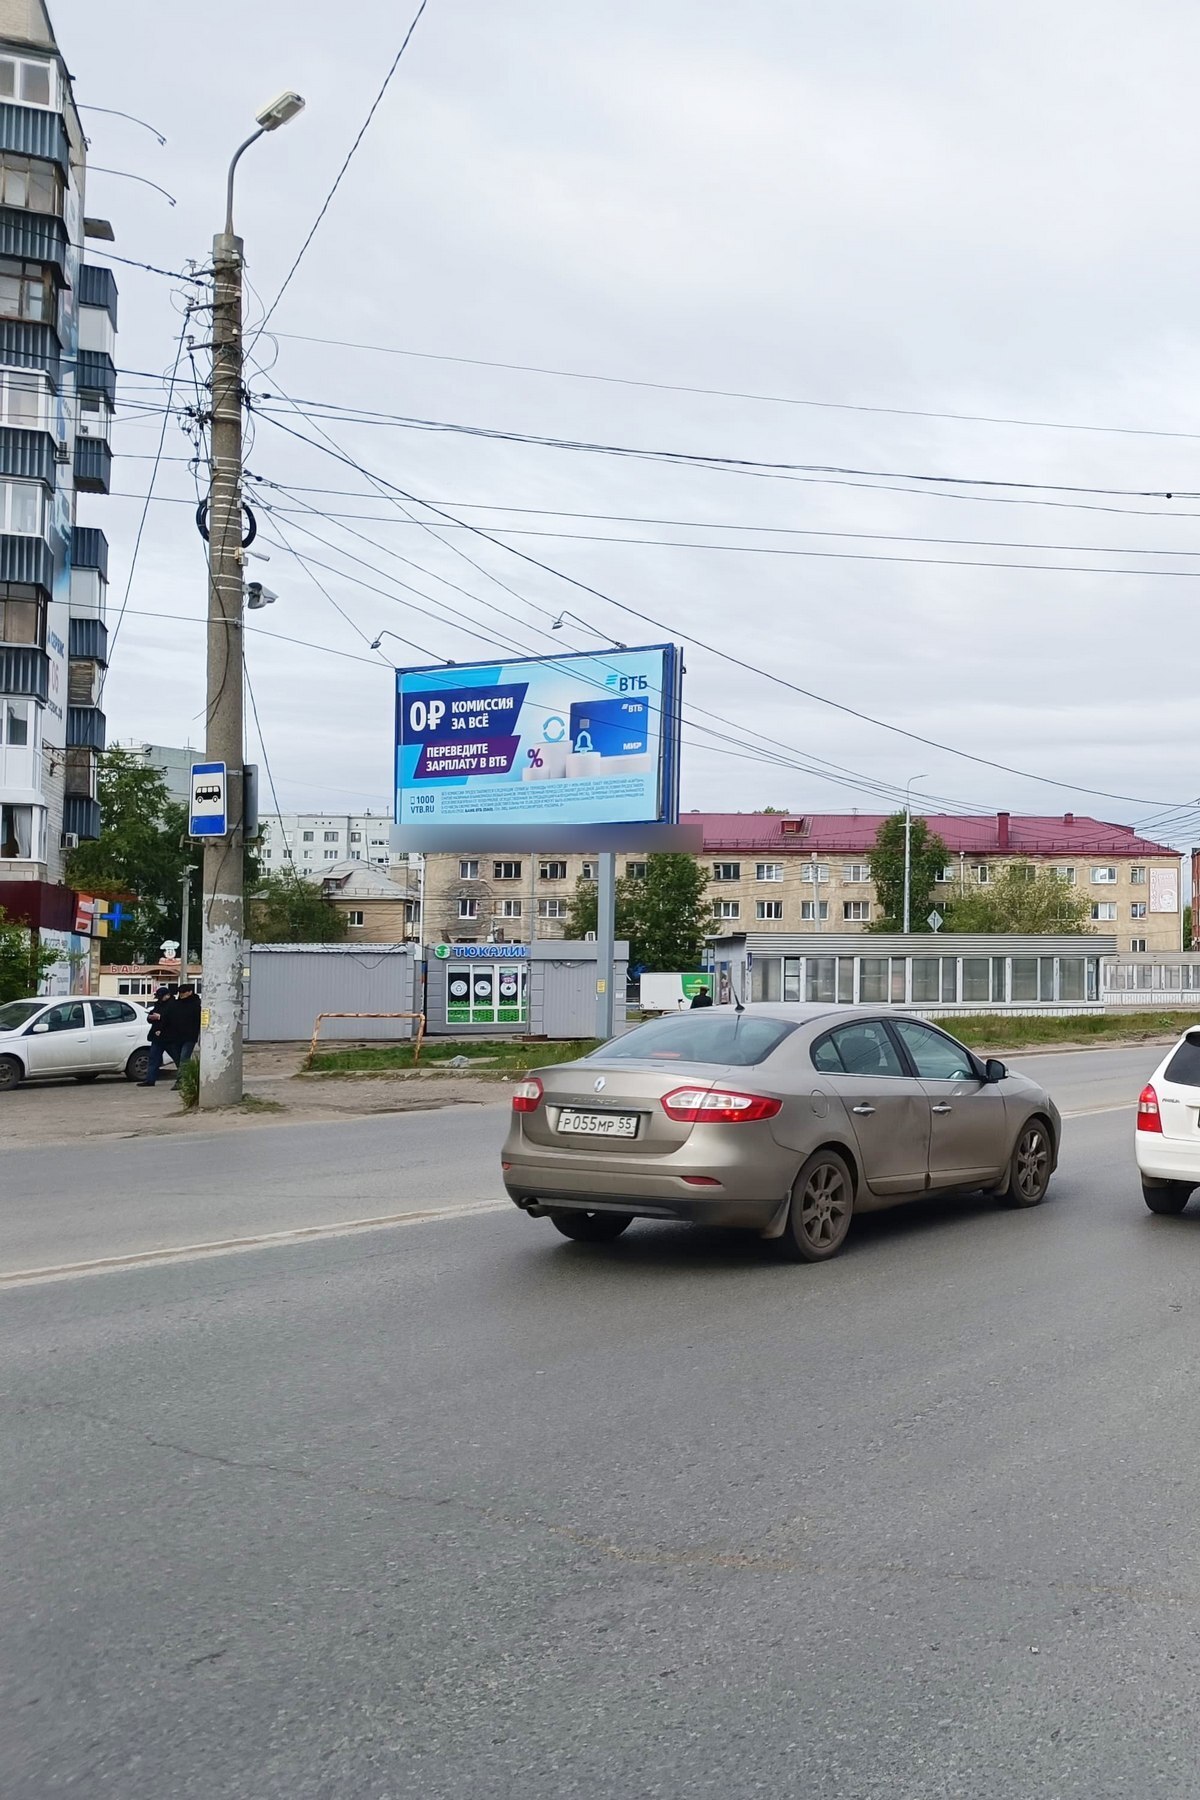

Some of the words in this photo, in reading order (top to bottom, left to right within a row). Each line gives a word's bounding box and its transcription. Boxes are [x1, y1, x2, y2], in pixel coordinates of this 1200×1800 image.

[619, 675, 648, 692] ВТБ
[451, 697, 514, 714] КОМИССИЯ
[628, 704, 643, 713] ВТБ
[451, 718, 466, 730] ЗА
[468, 713, 489, 728] ВСЁ
[426, 743, 488, 758] ПЕРЕВЕДИТЕ
[426, 758, 478, 772] ЗАРПЛАТУ
[480, 757, 487, 769] В
[488, 755, 507, 768] ВТБ
[416, 795, 435, 804] 1000
[410, 805, 435, 814] VTB.RU
[111, 965, 140, 973] БАР
[618, 1117, 632, 1129] 55
